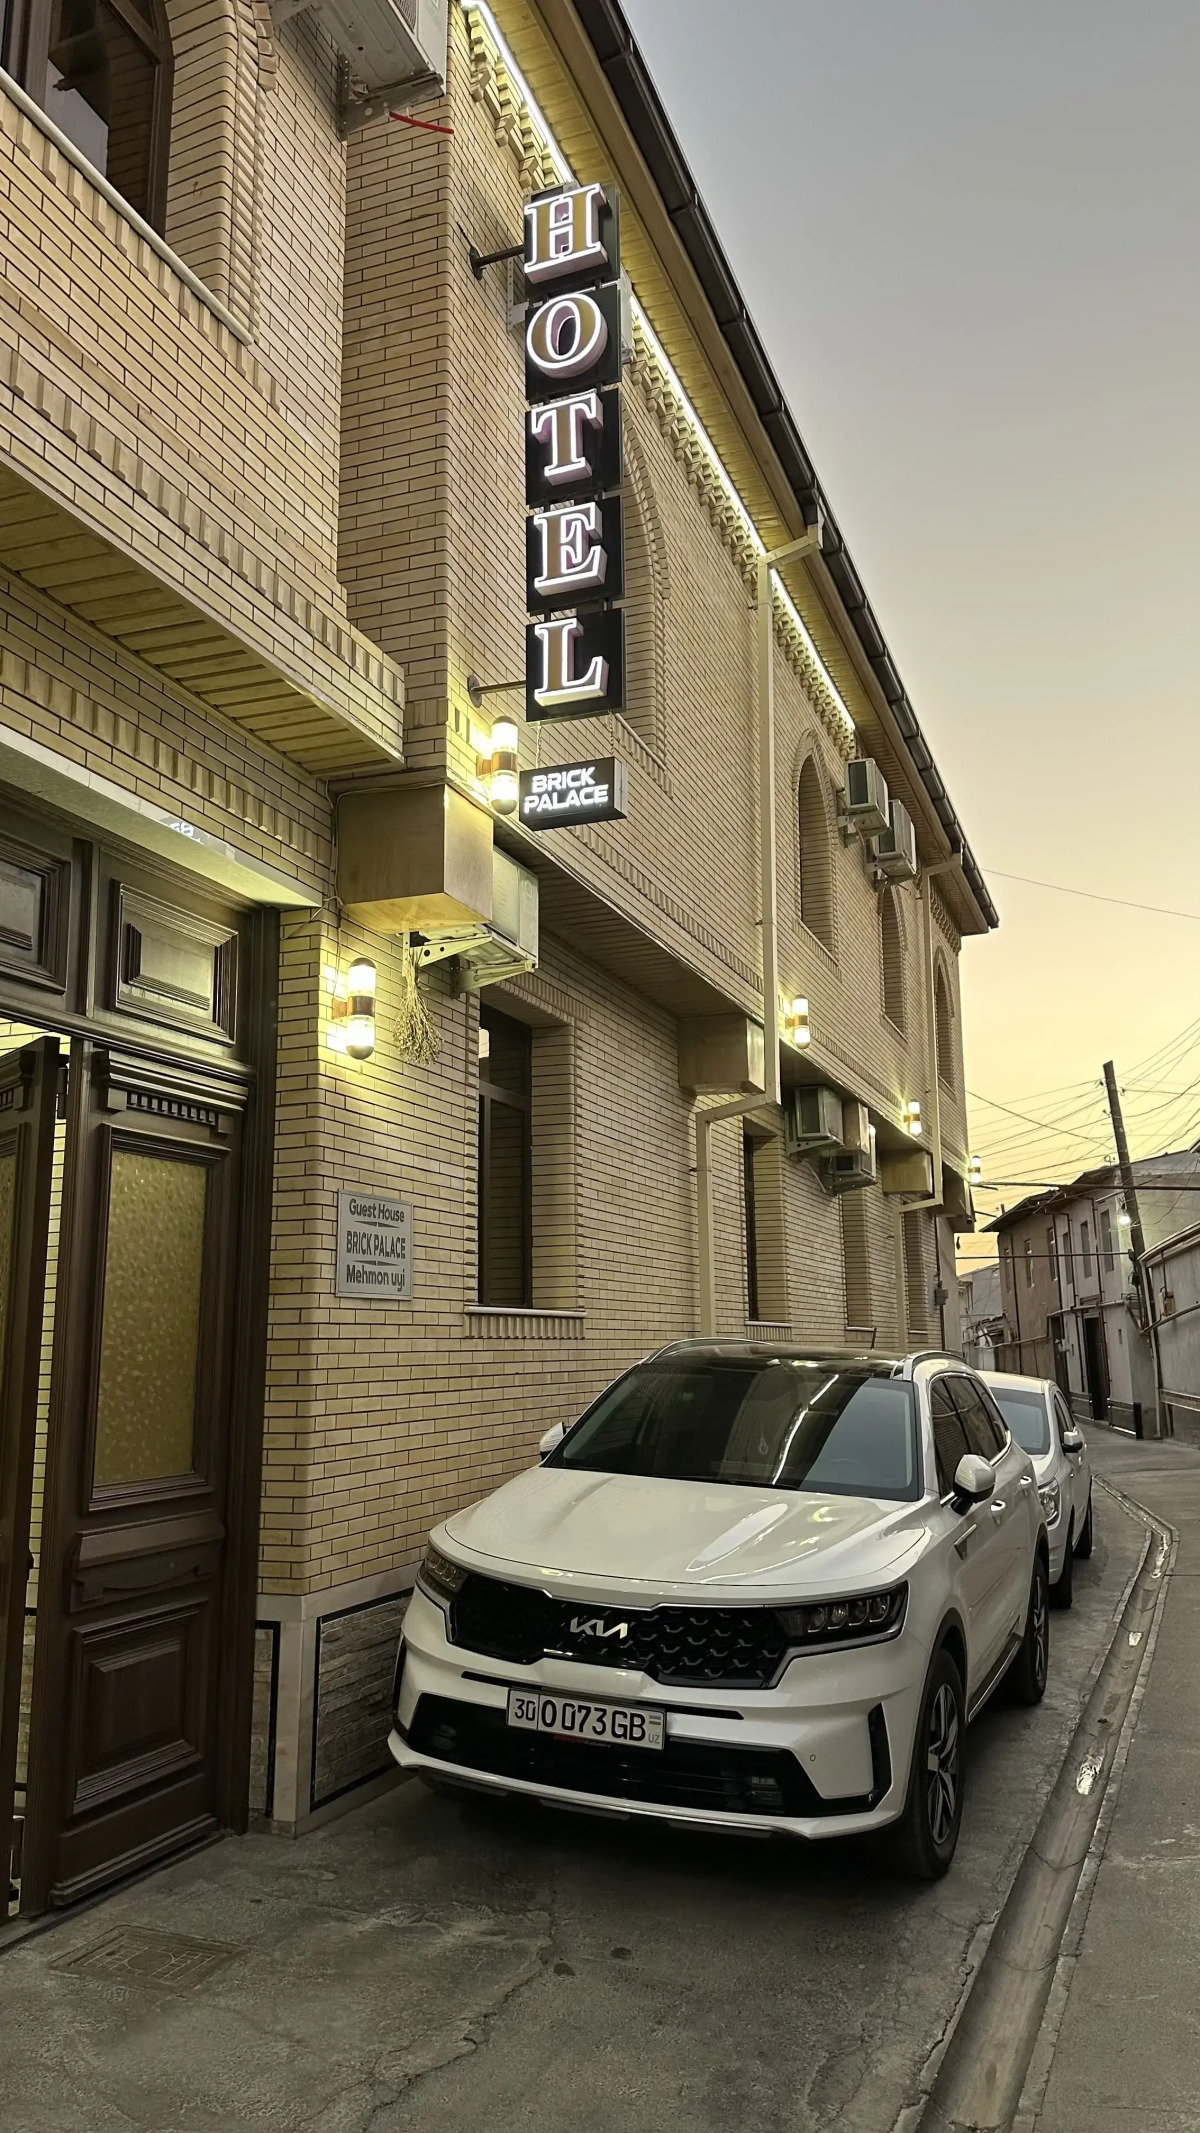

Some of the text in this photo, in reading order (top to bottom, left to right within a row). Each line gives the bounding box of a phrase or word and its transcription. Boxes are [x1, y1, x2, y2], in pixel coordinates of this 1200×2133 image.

[524, 183, 608, 707] HOTEL
[532, 767, 595, 793] BRICK
[524, 784, 609, 814] PALACE
[349, 1198, 405, 1222] Guest House
[346, 1230, 406, 1259] BRICK PALACE
[346, 1264, 405, 1292] Mehmon uyi
[570, 1616, 628, 1639] KIA
[514, 1698, 536, 1721] 30
[648, 1733, 660, 1744] UZ
